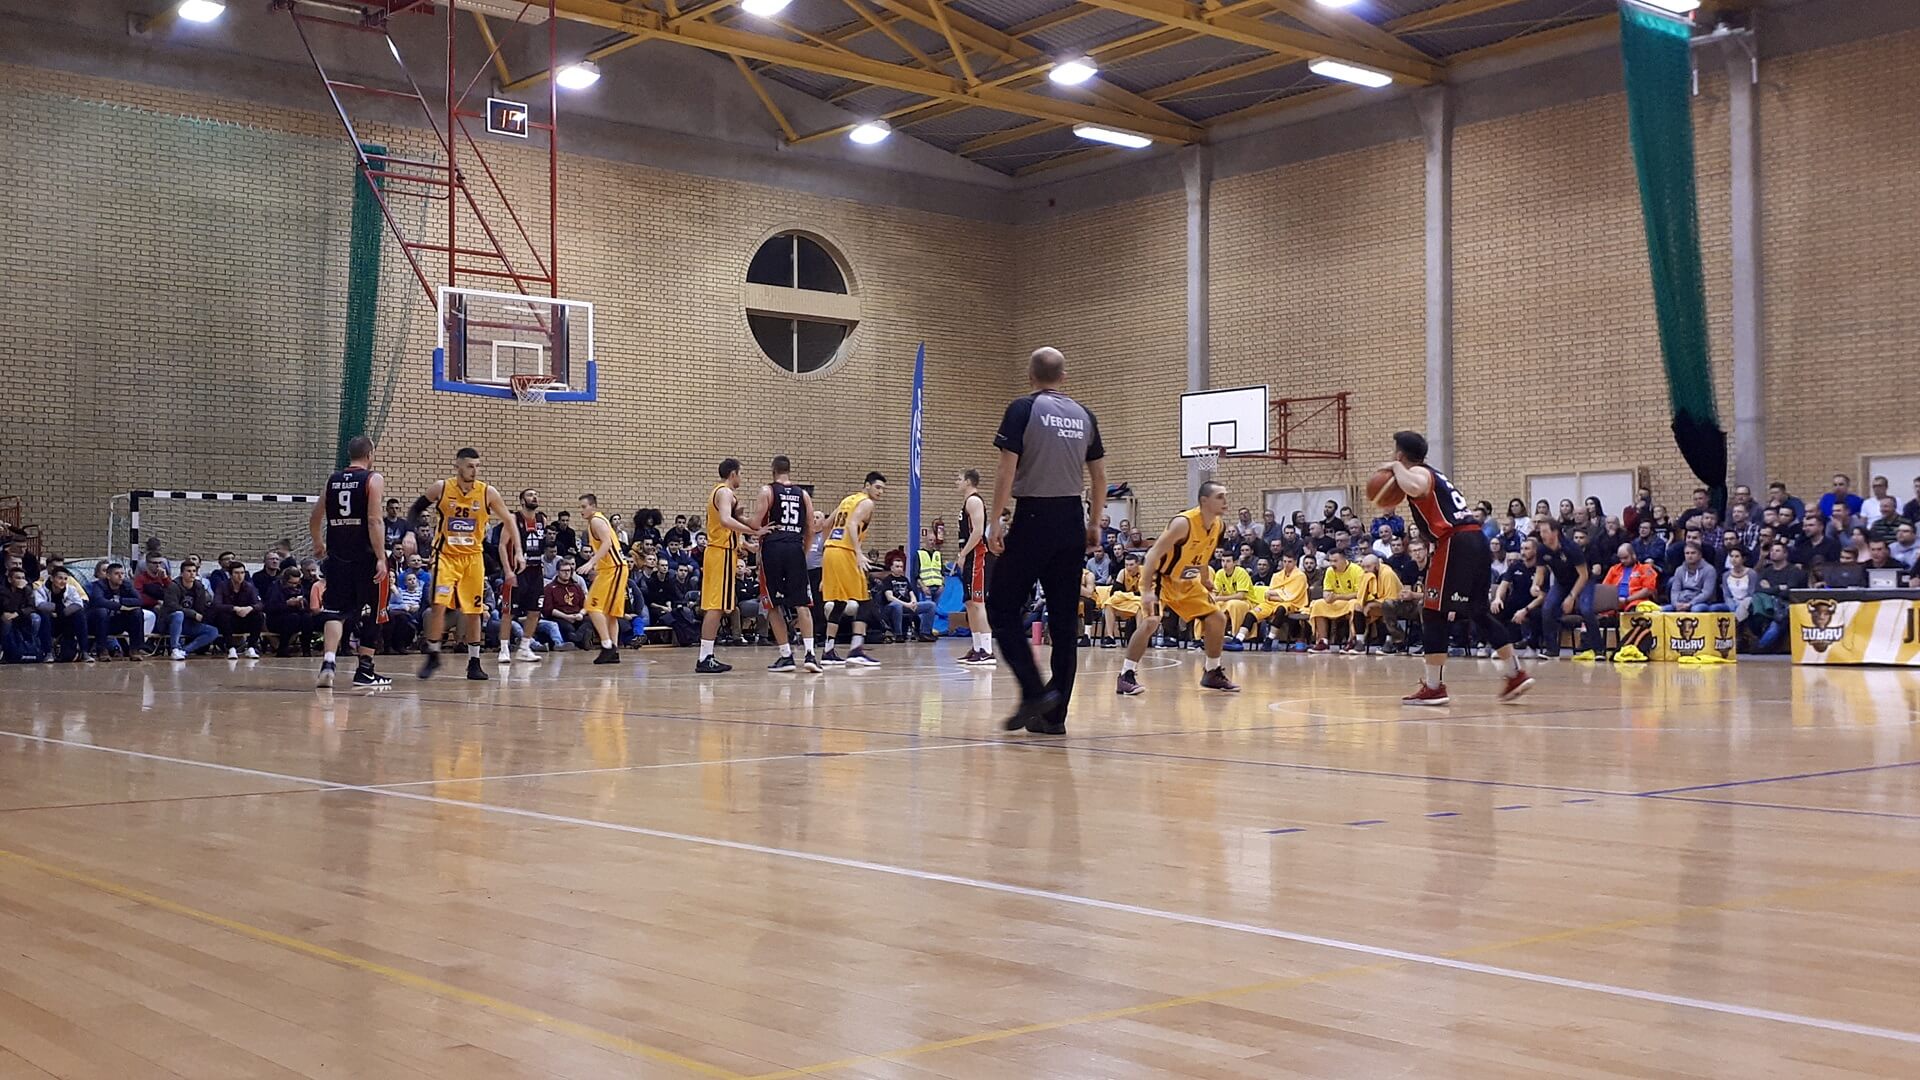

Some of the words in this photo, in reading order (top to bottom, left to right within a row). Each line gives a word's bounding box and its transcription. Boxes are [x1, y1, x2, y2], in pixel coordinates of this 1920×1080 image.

[1040, 413, 1084, 430] VERONI
[1057, 428, 1084, 440] active
[338, 490, 352, 517] 9
[455, 506, 470, 518] 26
[780, 501, 800, 524] 35
